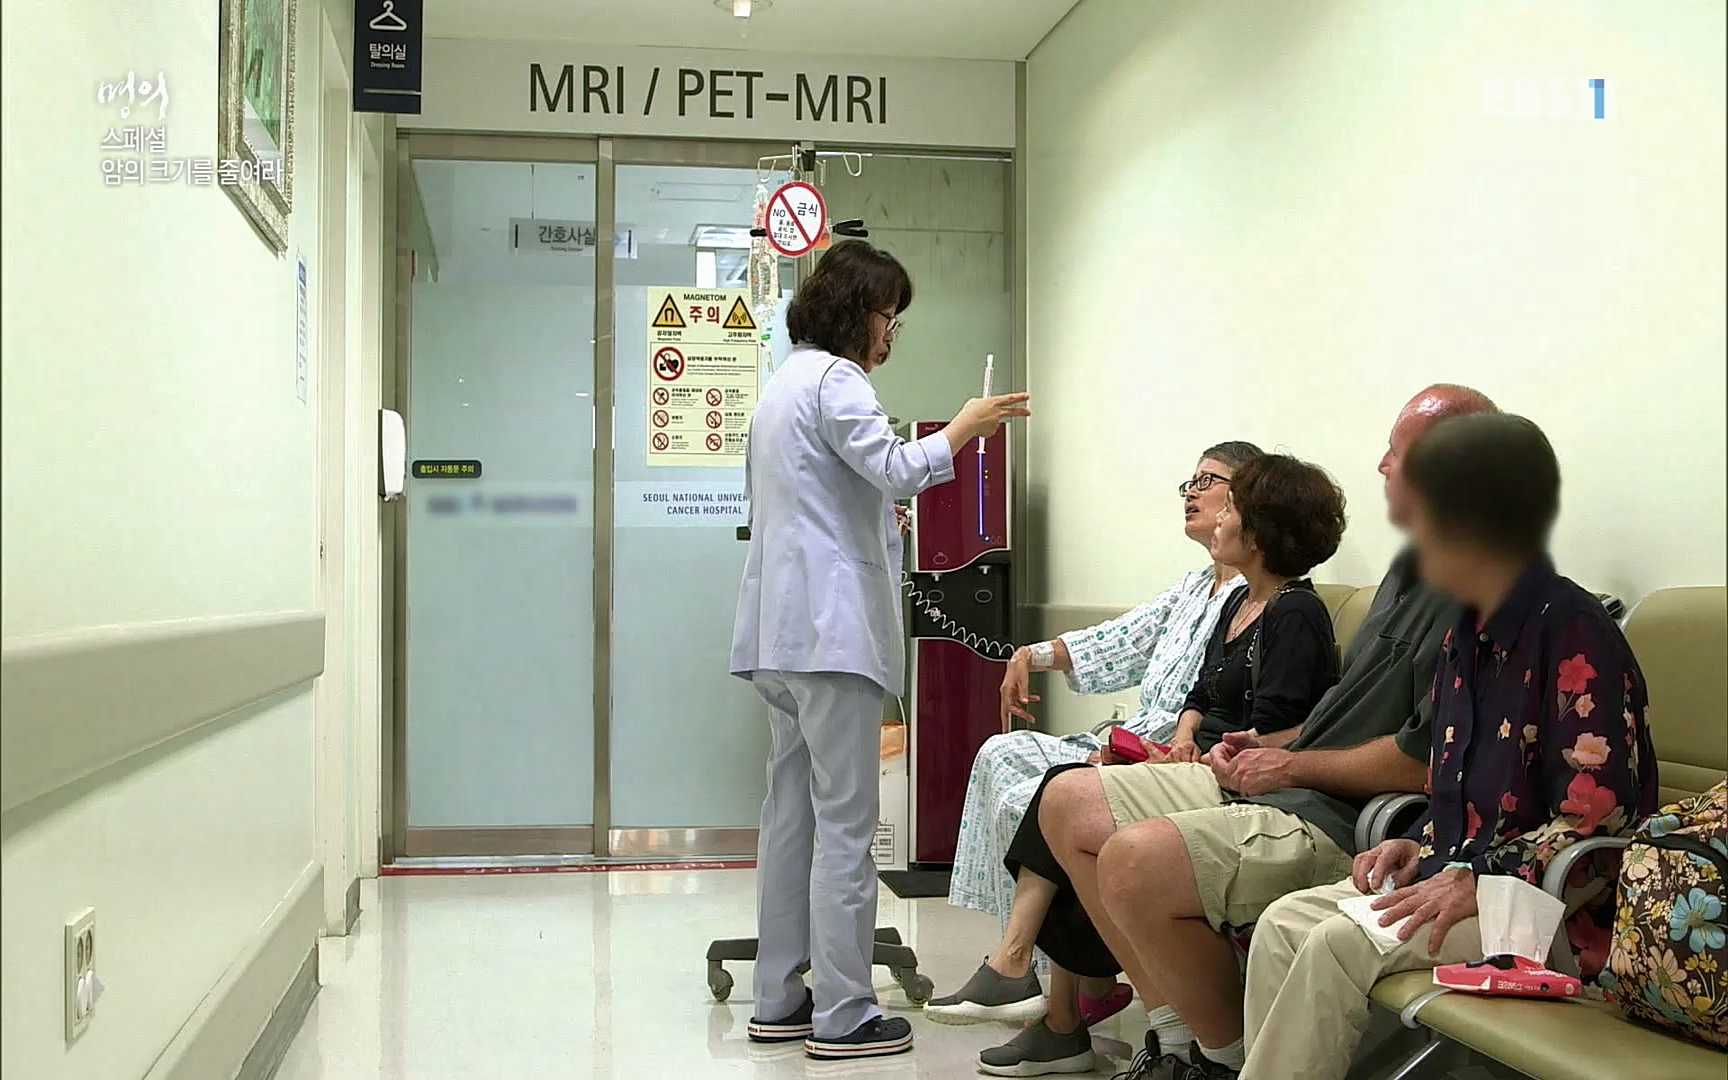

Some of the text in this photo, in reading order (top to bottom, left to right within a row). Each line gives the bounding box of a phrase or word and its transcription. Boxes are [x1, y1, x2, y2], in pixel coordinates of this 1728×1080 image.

[369, 43, 406, 60] 탈의실
[529, 63, 887, 124] MRI / PET-MRI
[773, 209, 786, 217] NO
[797, 202, 818, 217] 금식
[538, 225, 596, 246] 간호사실
[683, 293, 727, 301] MAGNETOM
[419, 464, 475, 474] 출입시 자동문 주의
[643, 493, 669, 502] SEOUL
[672, 493, 714, 502] NATIONAL
[667, 506, 743, 514] CANCER HOSPITAL
